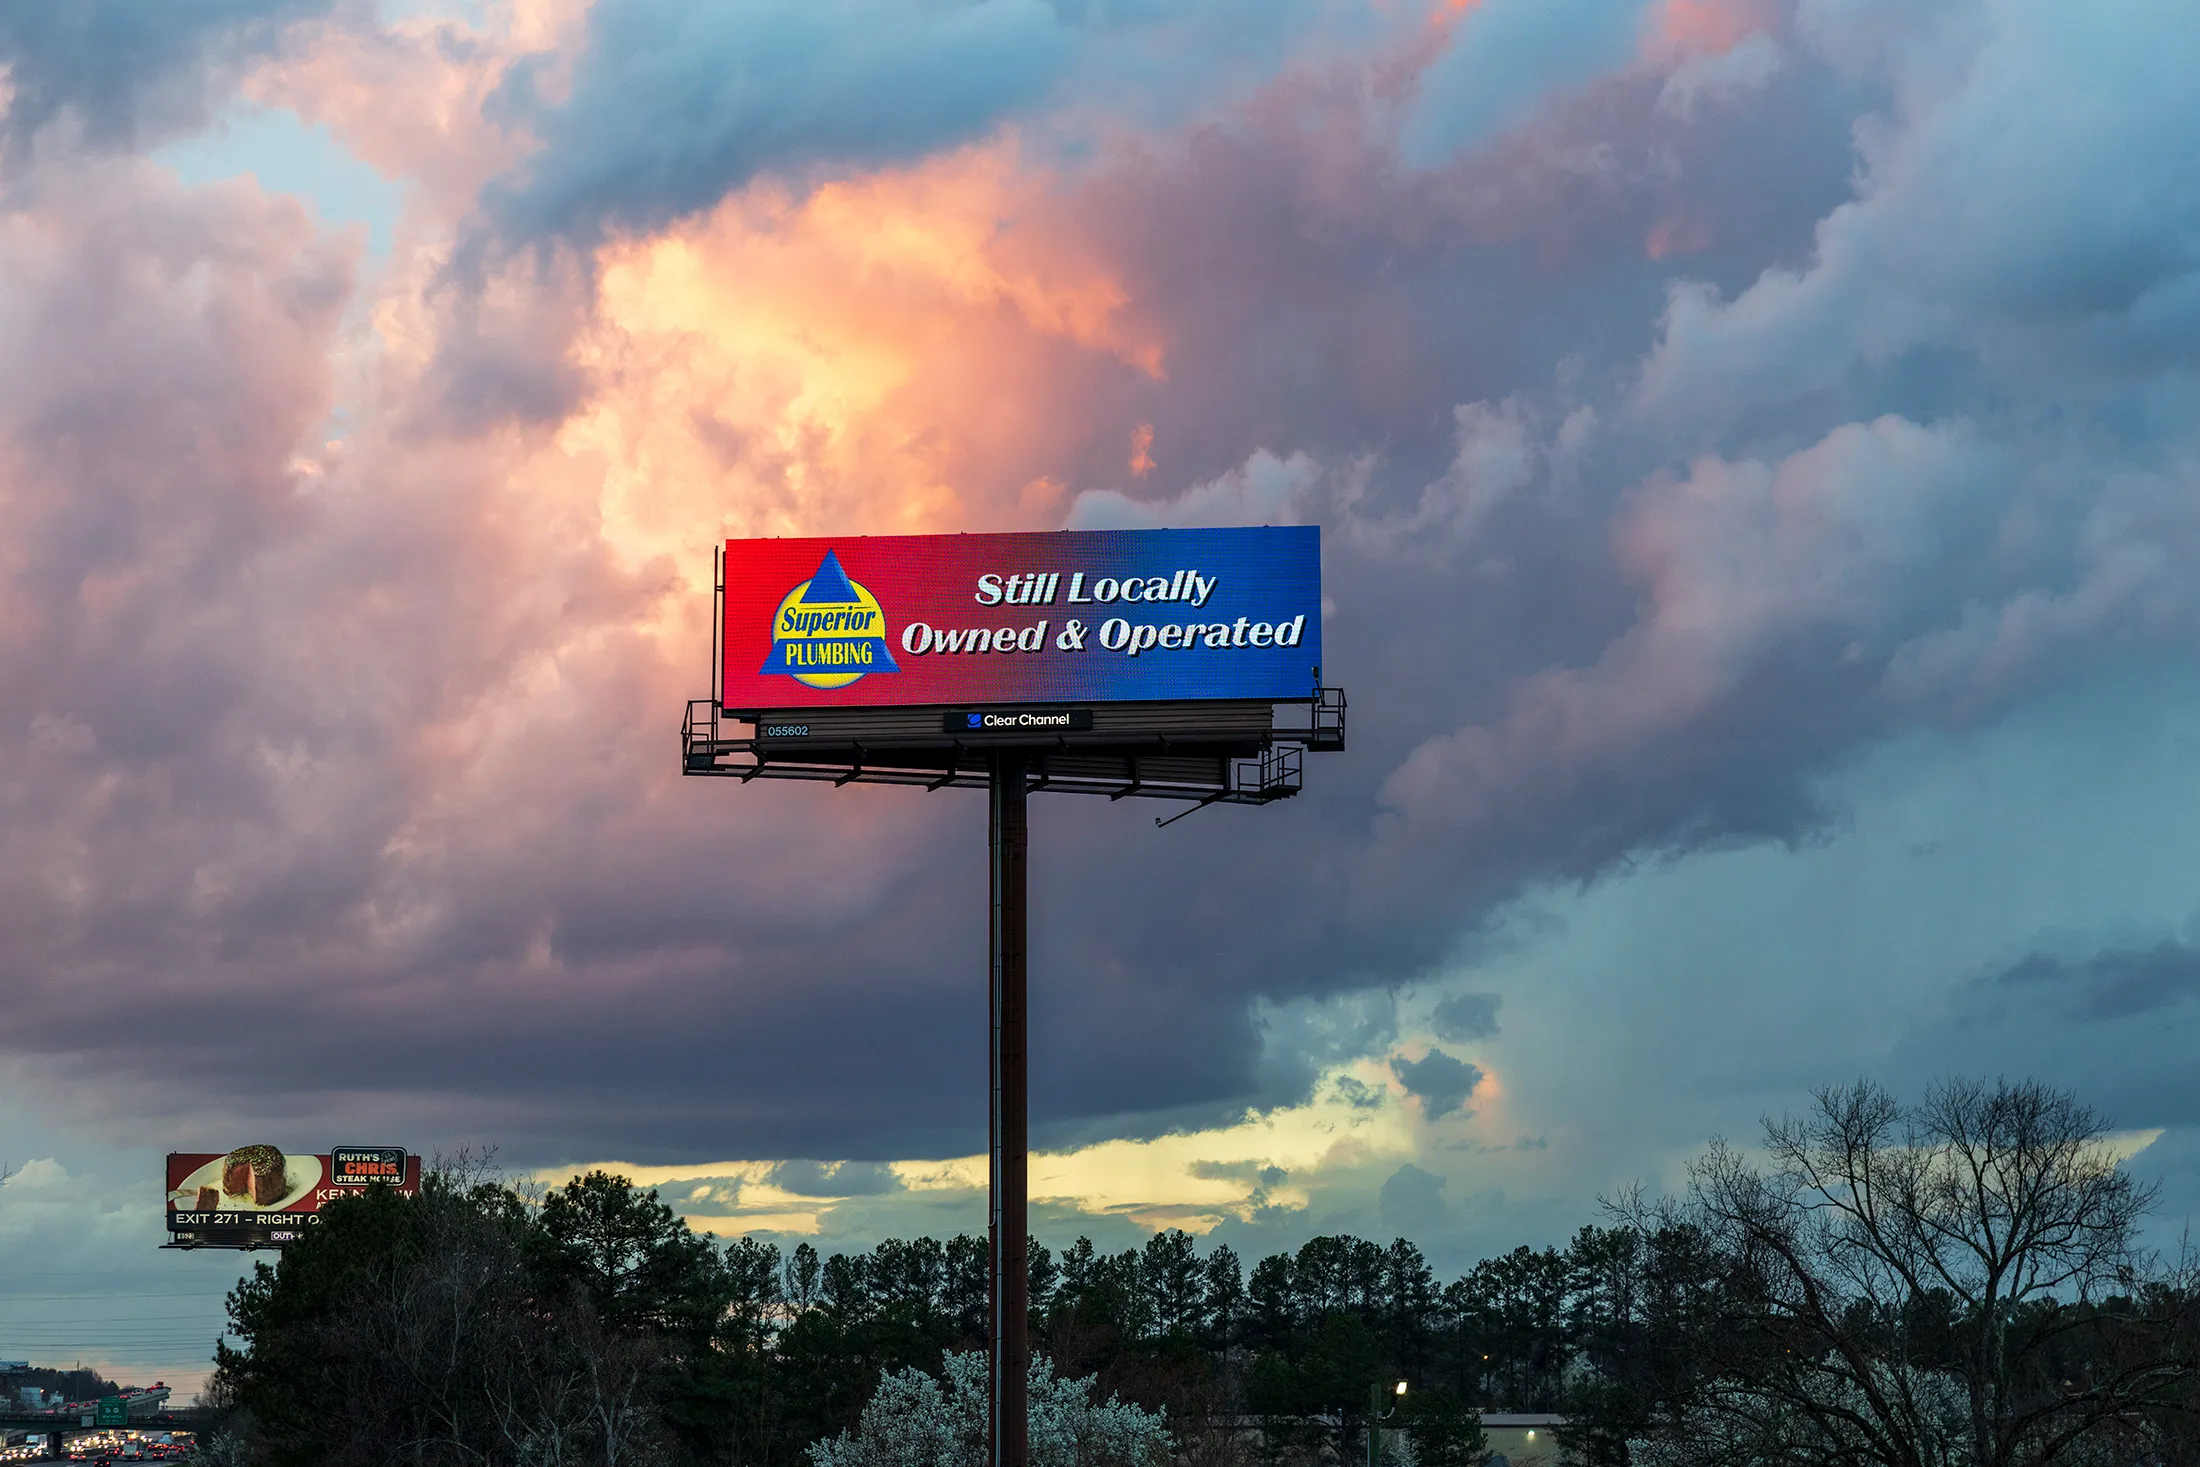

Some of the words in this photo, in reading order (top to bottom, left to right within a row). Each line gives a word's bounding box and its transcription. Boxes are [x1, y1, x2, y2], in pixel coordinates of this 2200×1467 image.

[975, 571, 1060, 606] Still
[1068, 569, 1218, 608] Locally
[781, 605, 876, 637] Superior
[901, 620, 1049, 655] Owned
[1056, 618, 1090, 653] &
[1098, 614, 1306, 656] Operated
[786, 641, 873, 666] PLUMBING
[983, 714, 1018, 727] Clear
[1019, 713, 1070, 726] Channel
[768, 725, 808, 737] 055602
[338, 1153, 380, 1162] RUTH'S
[344, 1162, 397, 1175] CHRIS
[336, 1174, 367, 1183] STEAK
[176, 1213, 210, 1224] EXIT
[213, 1213, 239, 1224] 271
[256, 1214, 303, 1225] RIGHT
